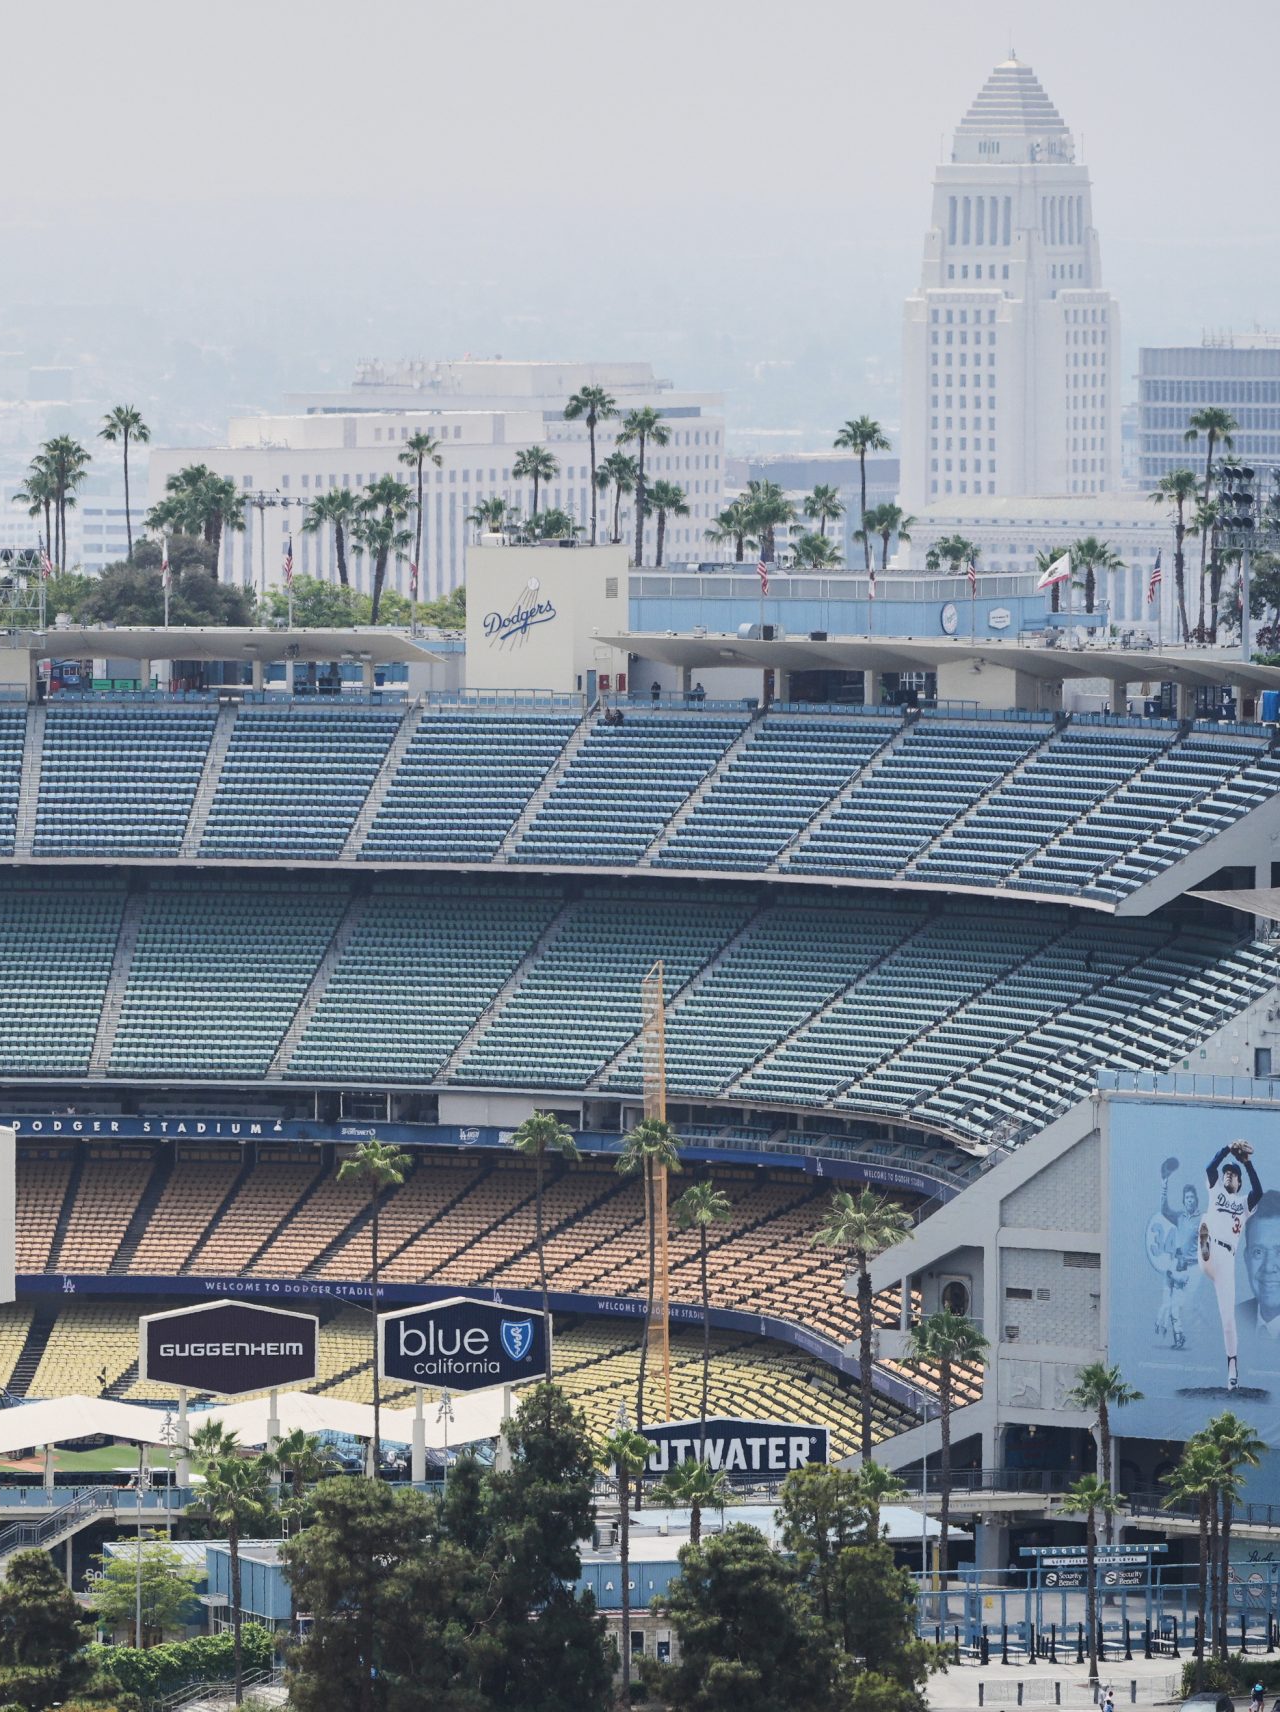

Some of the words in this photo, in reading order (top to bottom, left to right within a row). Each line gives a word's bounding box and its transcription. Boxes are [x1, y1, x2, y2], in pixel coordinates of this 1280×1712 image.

[483, 600, 557, 640] Dodgers
[12, 1120, 119, 1132] DODGER
[143, 1122, 262, 1134] STADIUM
[63, 1275, 76, 1293] LA
[205, 1281, 260, 1292] WELCOME
[265, 1283, 280, 1293] TO
[285, 1284, 331, 1295] DODGER
[597, 1300, 636, 1313] WELCOME
[680, 1308, 705, 1320] STADIU
[399, 1320, 489, 1356] blue
[159, 1342, 303, 1357] GUGGENHEIM
[414, 1358, 500, 1375] california
[644, 1436, 810, 1472] UTWATER
[1031, 1547, 1087, 1556] DODGER
[1097, 1545, 1161, 1553] STADIUM
[1118, 1570, 1143, 1579] Security
